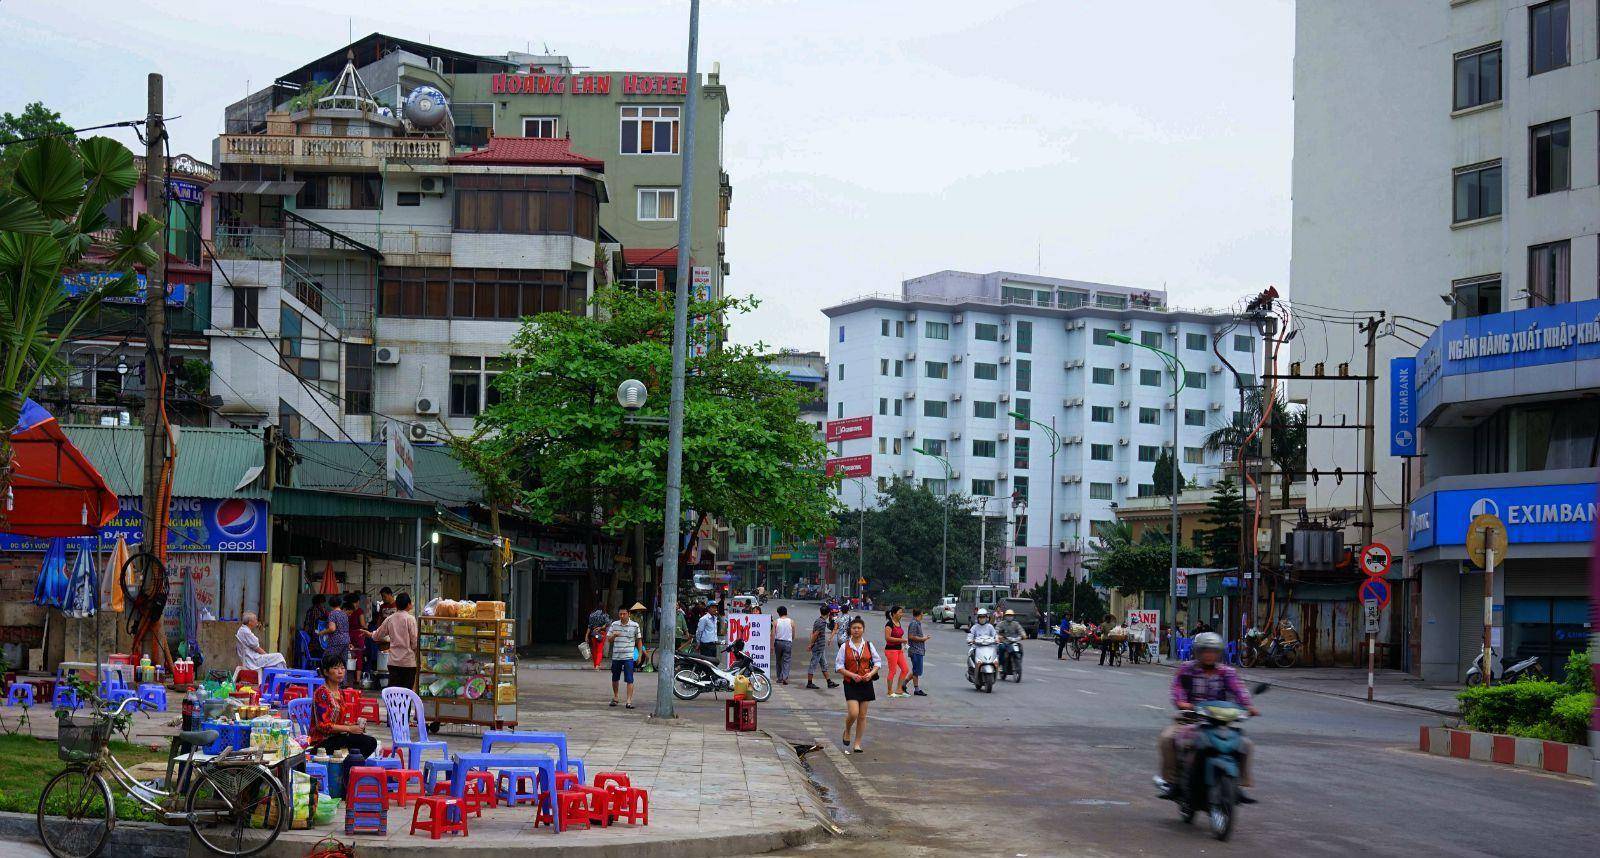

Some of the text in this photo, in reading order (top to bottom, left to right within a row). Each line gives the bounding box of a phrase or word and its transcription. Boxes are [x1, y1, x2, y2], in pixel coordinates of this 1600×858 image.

[570, 75, 612, 95] LAN
[623, 74, 688, 96] HOTEL
[1448, 334, 1479, 360] NGÂN
[1480, 331, 1511, 357] HÀNG
[1511, 321, 1542, 353] XUẤT
[1543, 321, 1577, 350] NHẬP
[1400, 367, 1409, 424] EXIMBANK
[218, 540, 255, 552] pepsi
[729, 615, 751, 643] Phở
[751, 621, 761, 629] Bò
